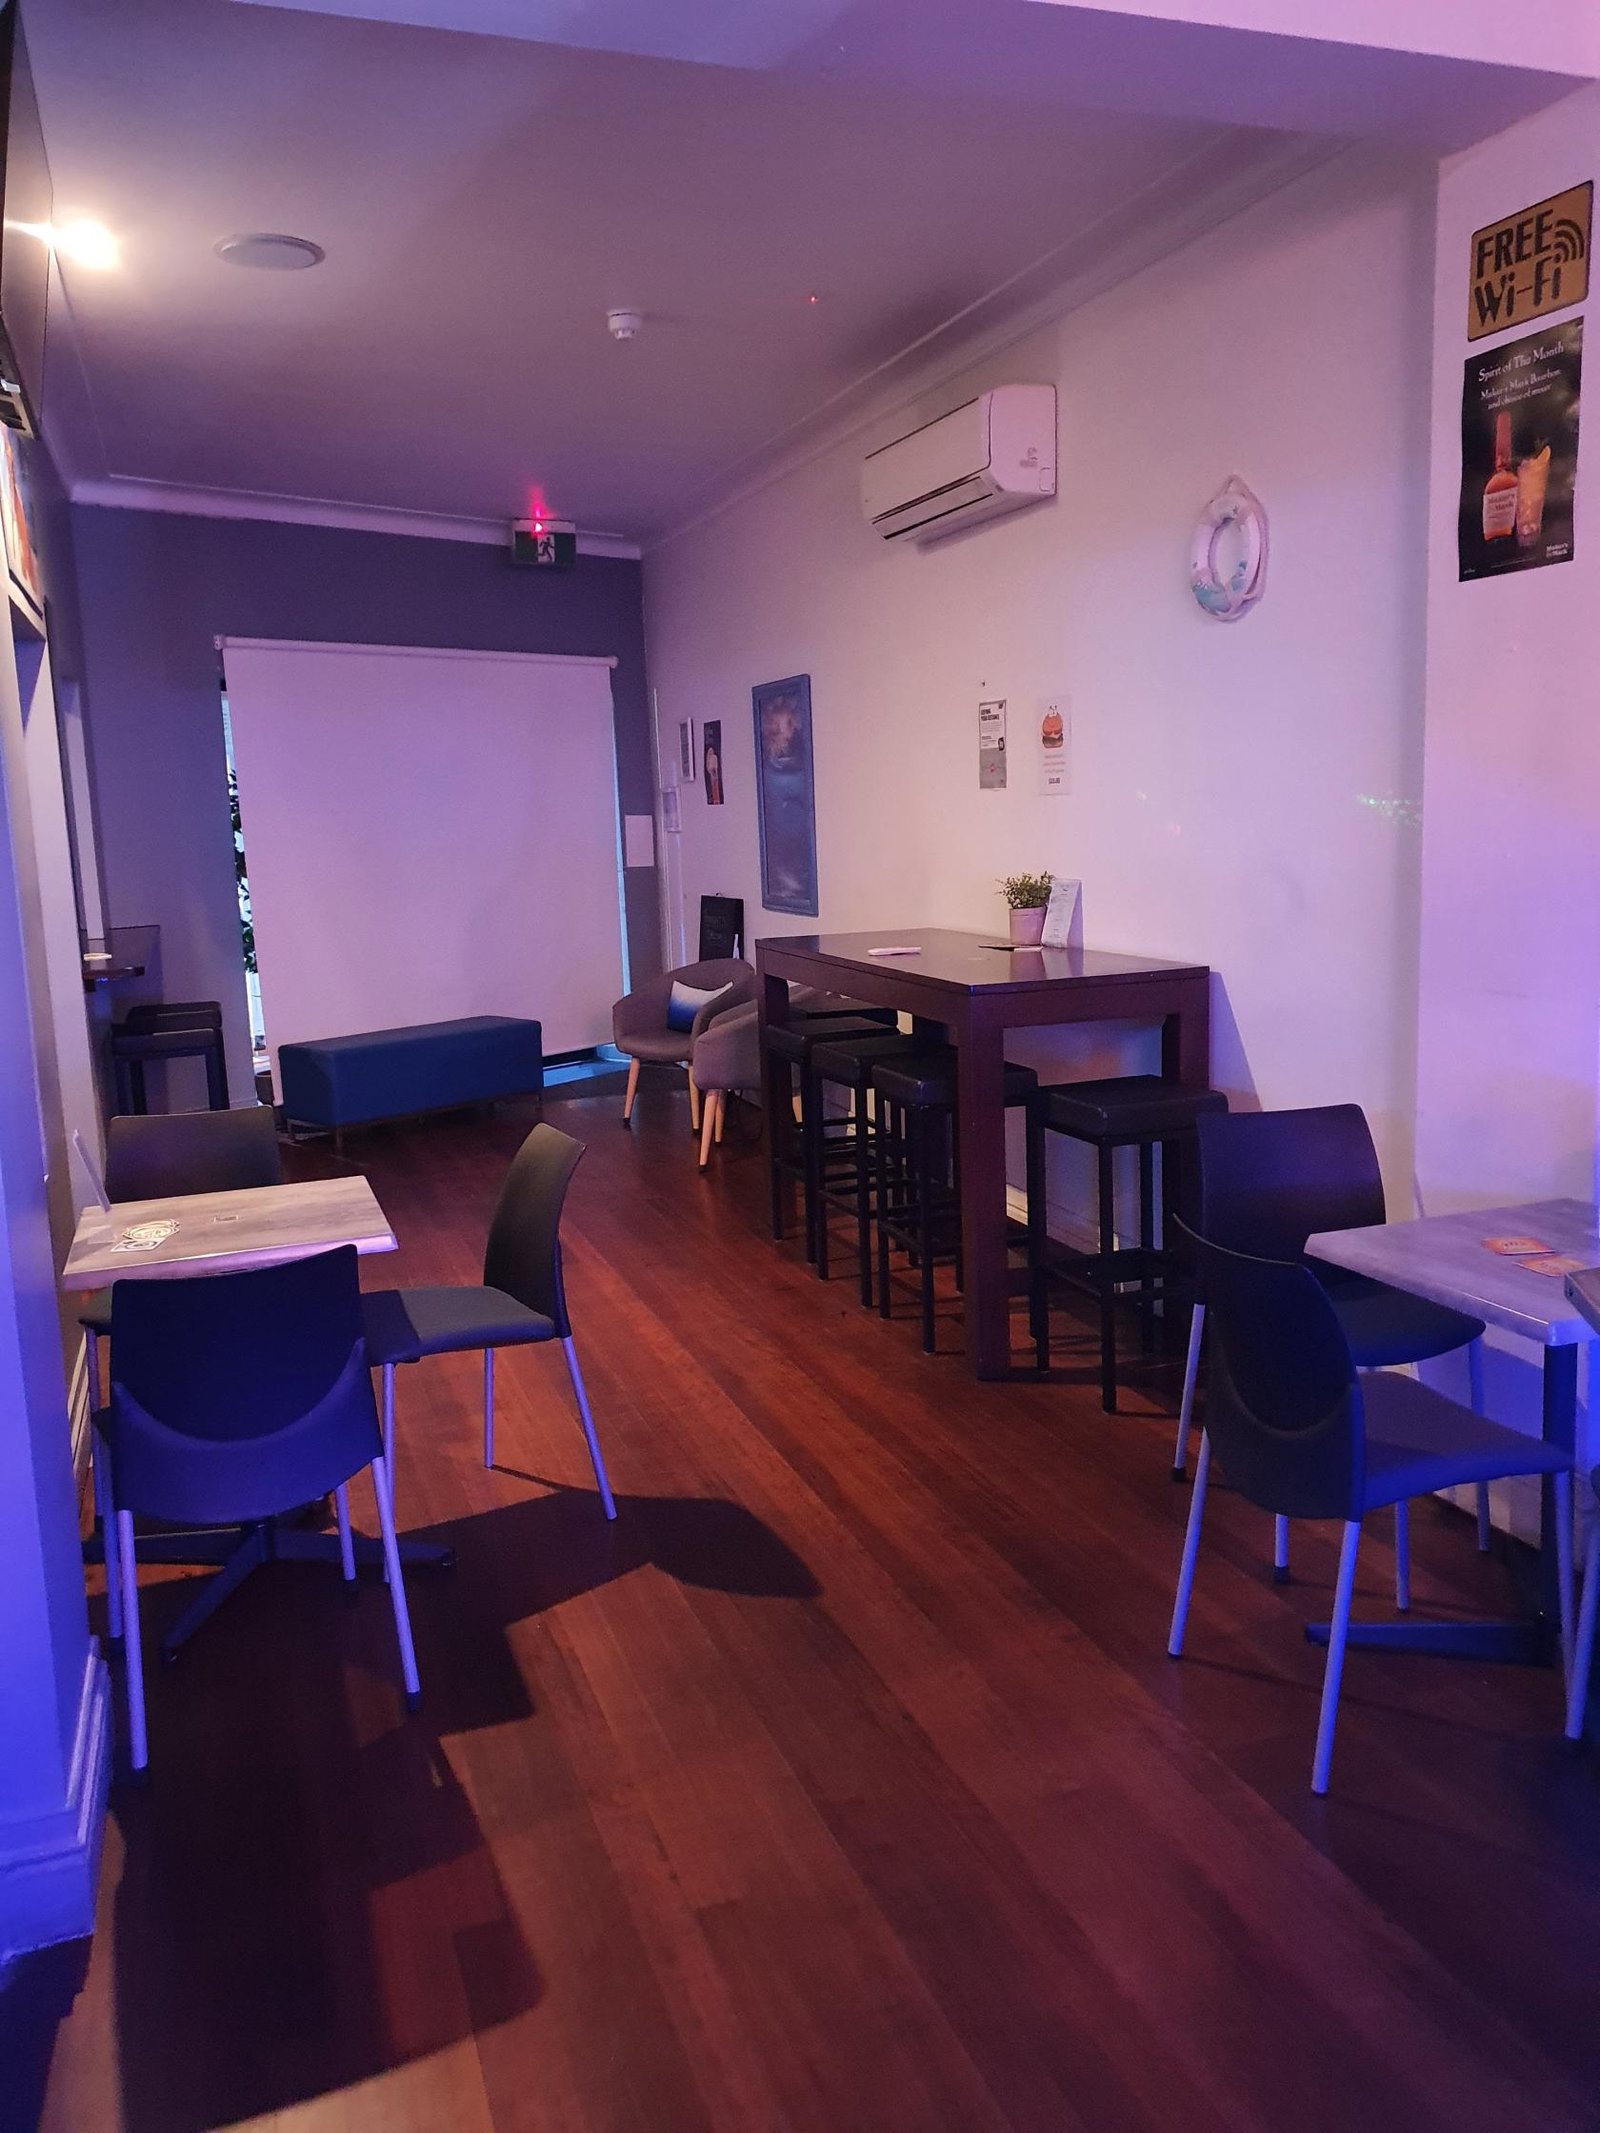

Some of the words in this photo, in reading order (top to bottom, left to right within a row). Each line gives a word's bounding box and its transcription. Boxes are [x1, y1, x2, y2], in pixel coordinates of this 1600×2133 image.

[1476, 209, 1553, 279] FREE
[1474, 253, 1561, 327] Wi-Fi
[1478, 364, 1501, 382] Spirit
[1502, 359, 1512, 373] of
[1513, 354, 1531, 369] The
[1533, 341, 1564, 362] Month
